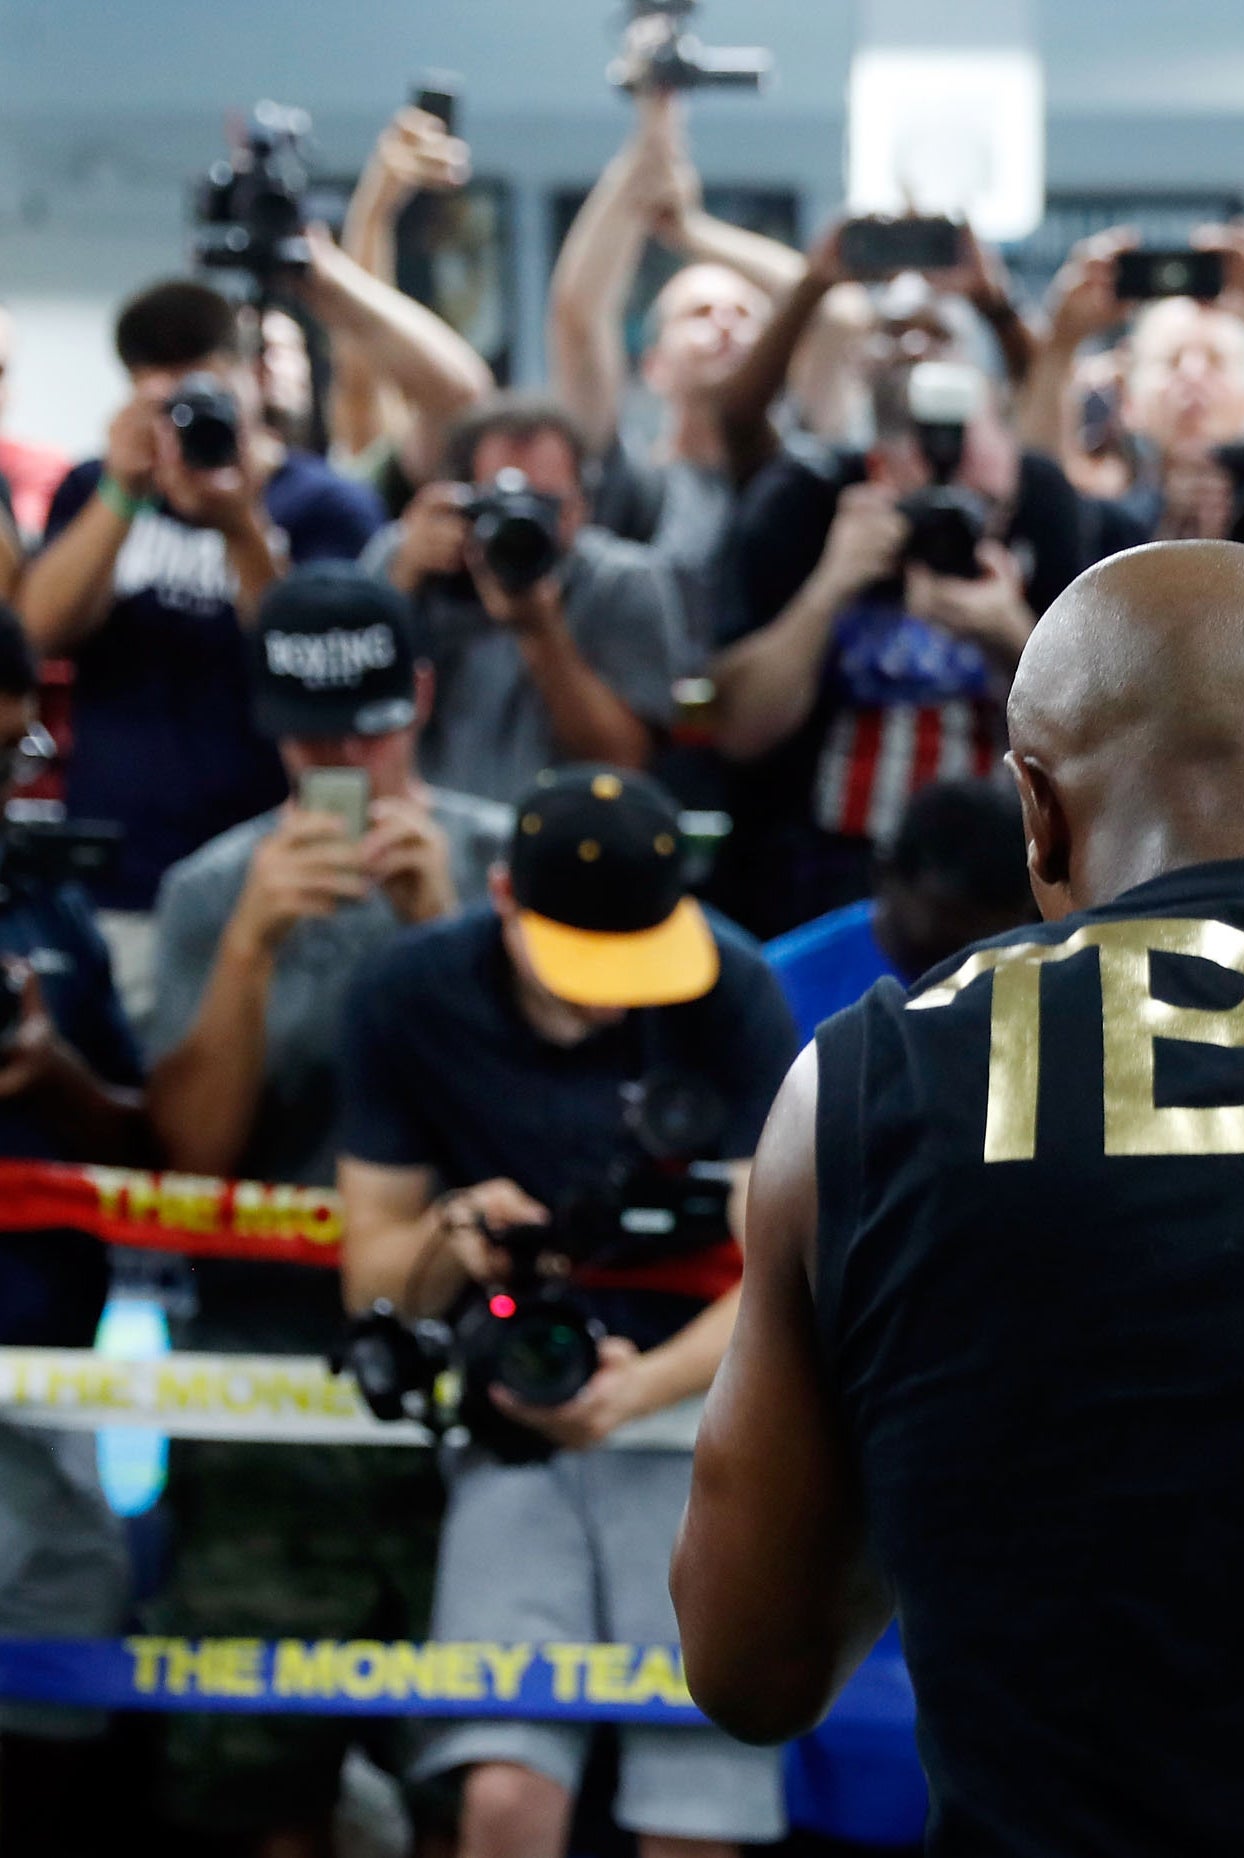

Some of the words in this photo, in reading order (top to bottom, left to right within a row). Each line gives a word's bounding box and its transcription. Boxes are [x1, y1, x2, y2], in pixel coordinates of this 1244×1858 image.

[265, 623, 396, 680] BOXING
[84, 1164, 222, 1234] THE
[8, 1360, 133, 1410] THE
[155, 1364, 356, 1417] MONE
[127, 1635, 262, 1697] THE
[274, 1638, 533, 1701] MONEY
